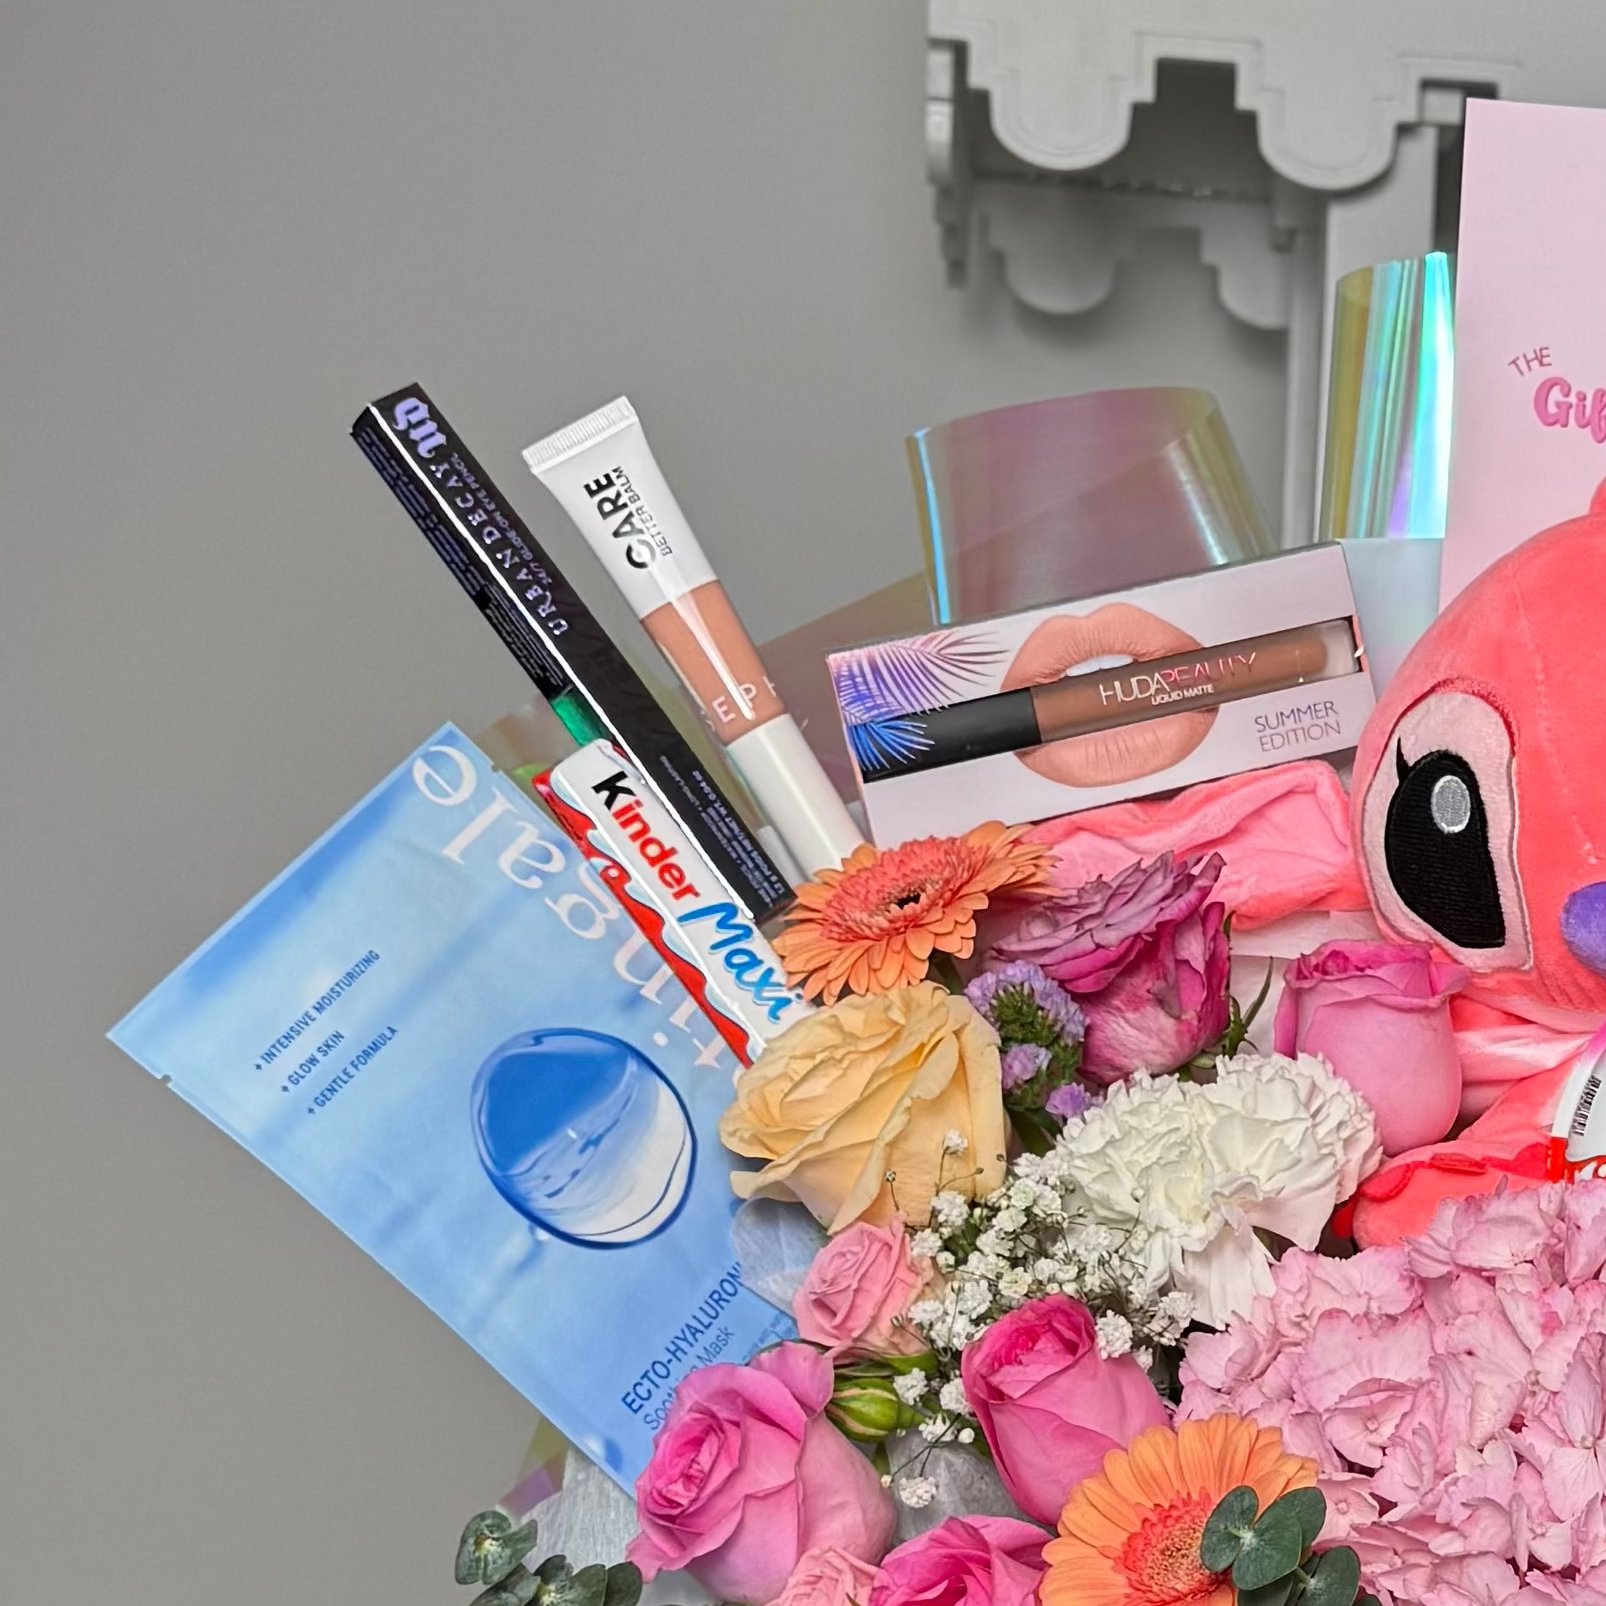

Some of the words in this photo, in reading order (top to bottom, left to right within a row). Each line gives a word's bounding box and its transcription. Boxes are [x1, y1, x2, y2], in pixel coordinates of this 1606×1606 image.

[1507, 346, 1553, 377] THE
[451, 452, 481, 490] PENCIL
[611, 466, 641, 505] BALM
[429, 461, 502, 545] DECAY
[475, 488, 496, 511] EYE
[583, 472, 657, 569] CARE
[635, 505, 673, 557] BETTER
[495, 548, 569, 636] URBAN
[1151, 691, 1183, 706] LIQUID
[1183, 683, 1214, 698] MATTE
[1254, 700, 1339, 733] SUMMER
[1258, 719, 1342, 752] EDITION
[411, 745, 742, 1080] tingale
[591, 770, 701, 902] Kinder
[677, 902, 802, 1024] Maxi
[260, 1010, 317, 1065] INTENSIVE
[312, 949, 381, 1016] MOISTURIZING
[287, 1053, 321, 1086] GLOW
[316, 1030, 345, 1057] SKIN
[313, 1067, 355, 1108] GENTLE
[350, 1025, 399, 1072] FORMULA
[621, 1261, 743, 1416] ECTO-HYALURON
[696, 1325, 735, 1366] Mask
